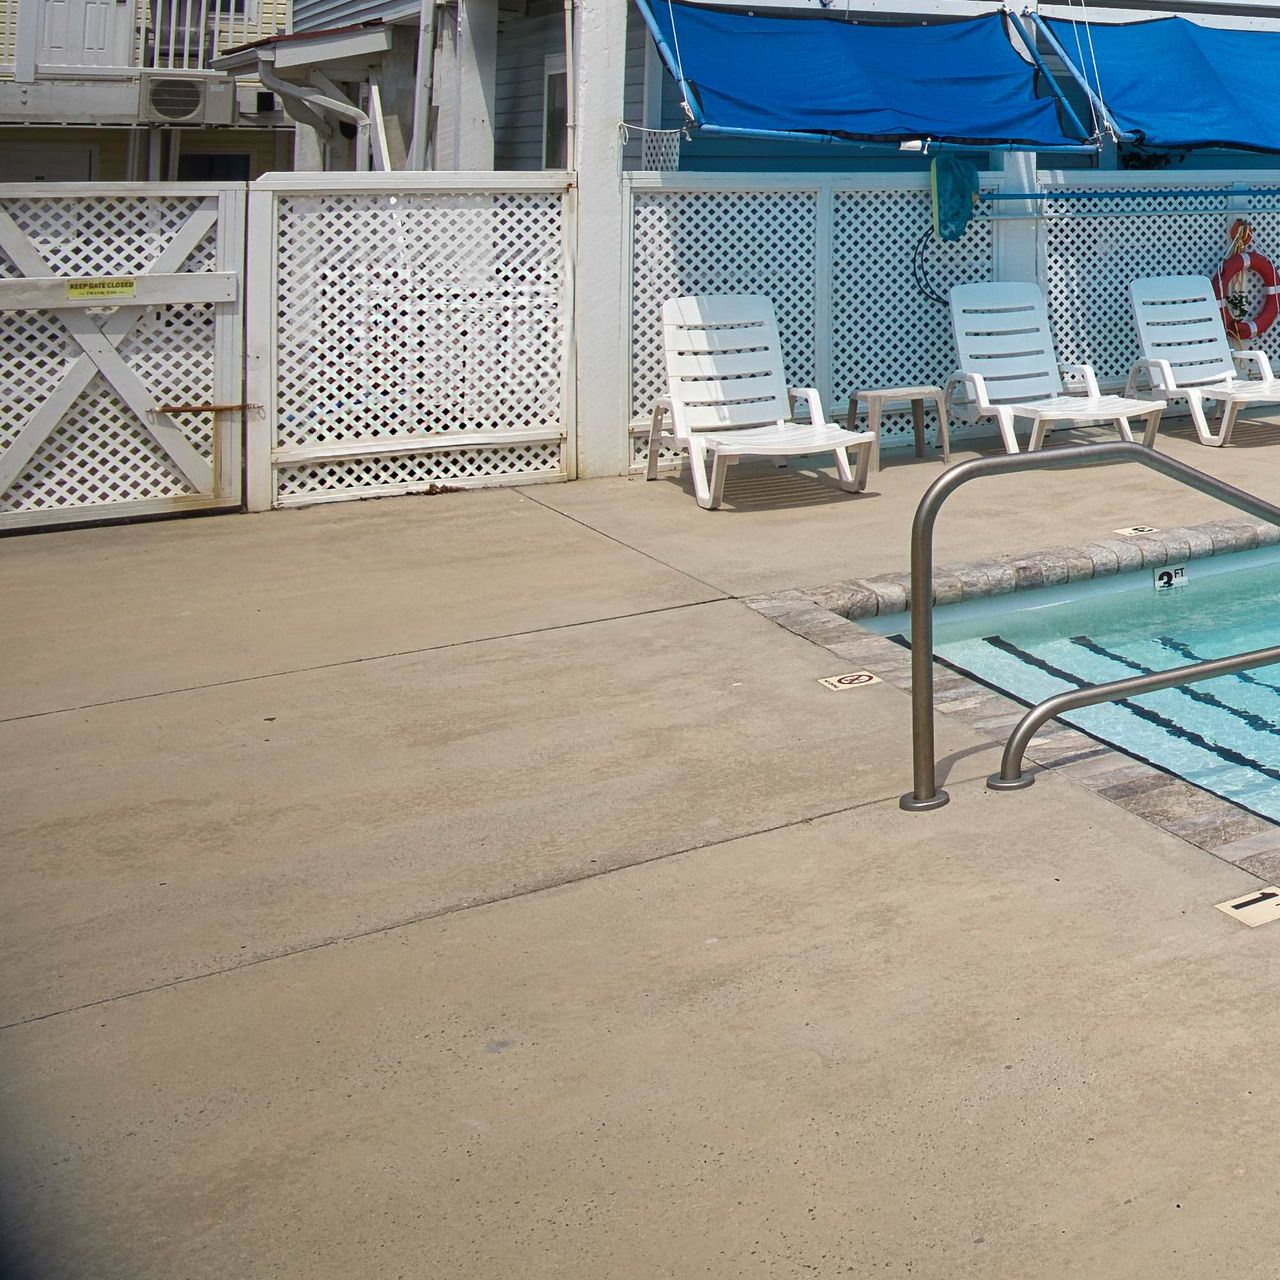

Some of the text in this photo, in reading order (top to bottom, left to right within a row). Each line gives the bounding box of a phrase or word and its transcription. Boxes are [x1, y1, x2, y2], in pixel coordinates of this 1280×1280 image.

[106, 281, 134, 289] CLOSED
[1173, 567, 1185, 579] FT
[1230, 891, 1280, 910] 1
